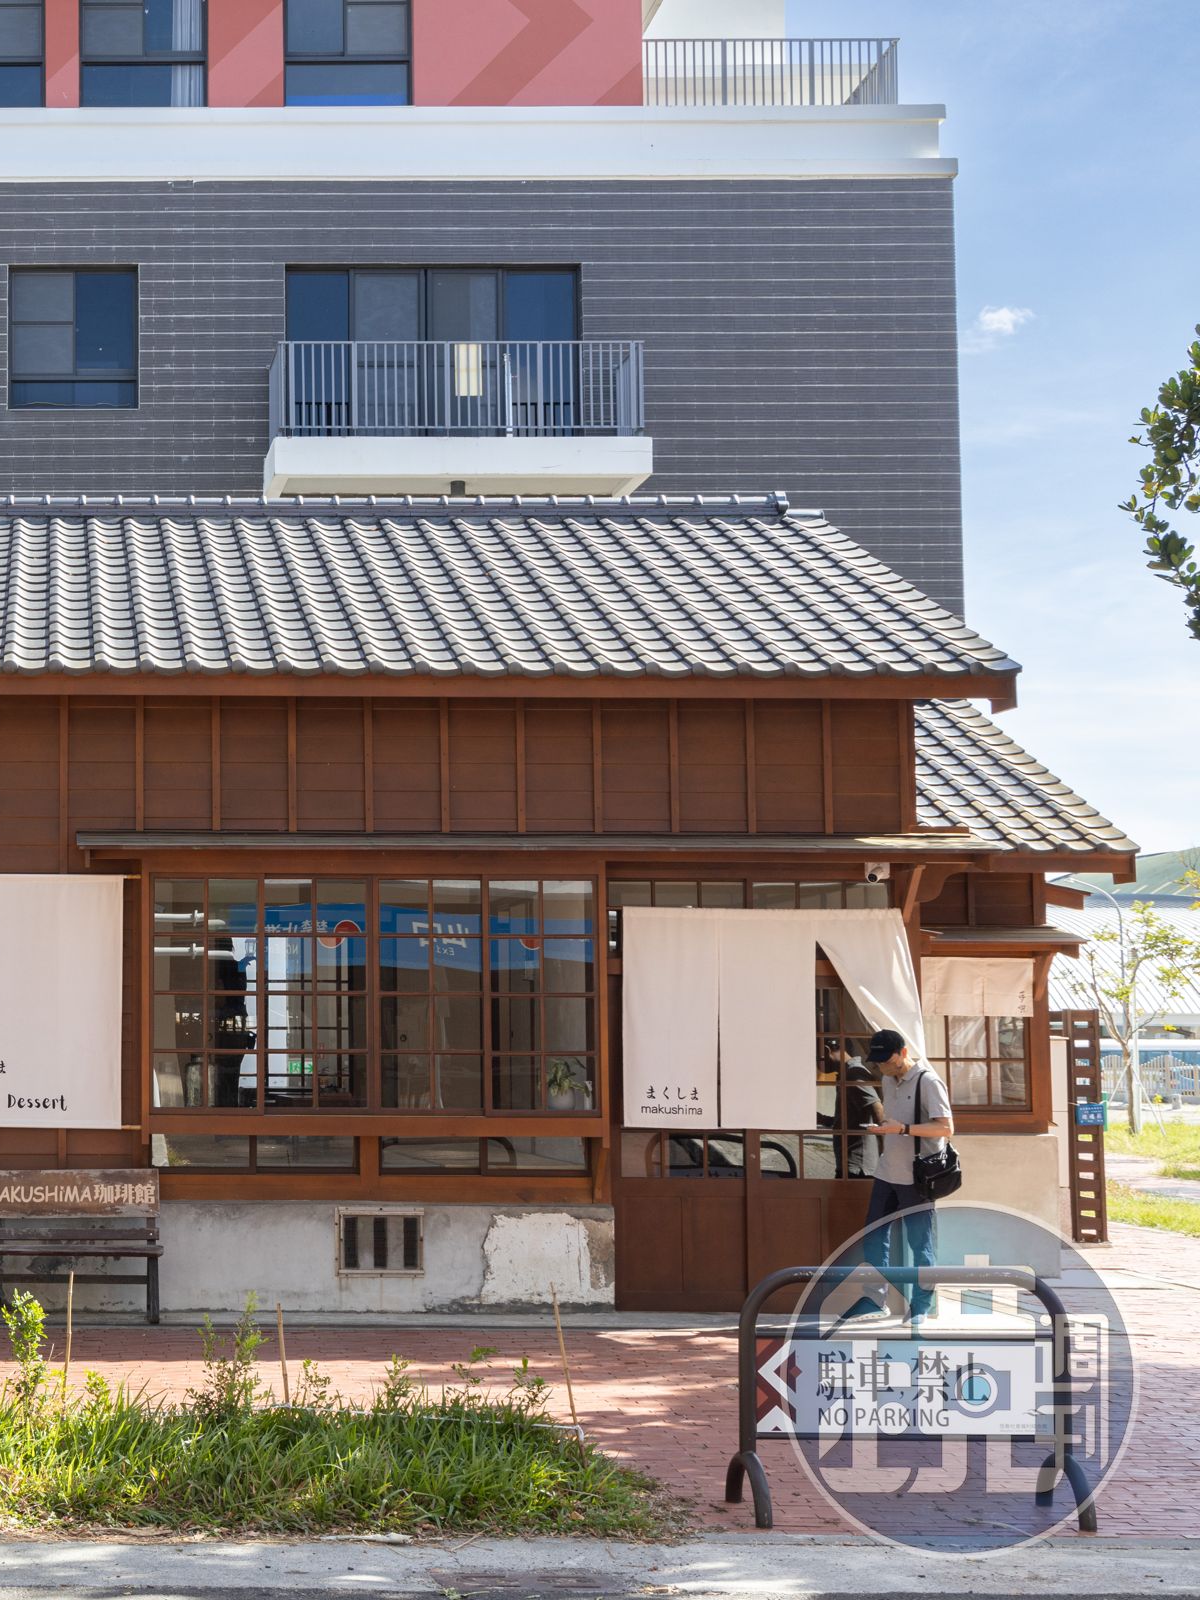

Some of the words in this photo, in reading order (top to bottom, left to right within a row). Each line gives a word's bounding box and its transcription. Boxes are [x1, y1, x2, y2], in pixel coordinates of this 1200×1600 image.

[646, 1084, 699, 1101] まくしま
[7, 1093, 68, 1111] Dessert
[640, 1104, 703, 1115] makushima
[818, 1407, 849, 1427] NO
[855, 1407, 950, 1427] PARKING
